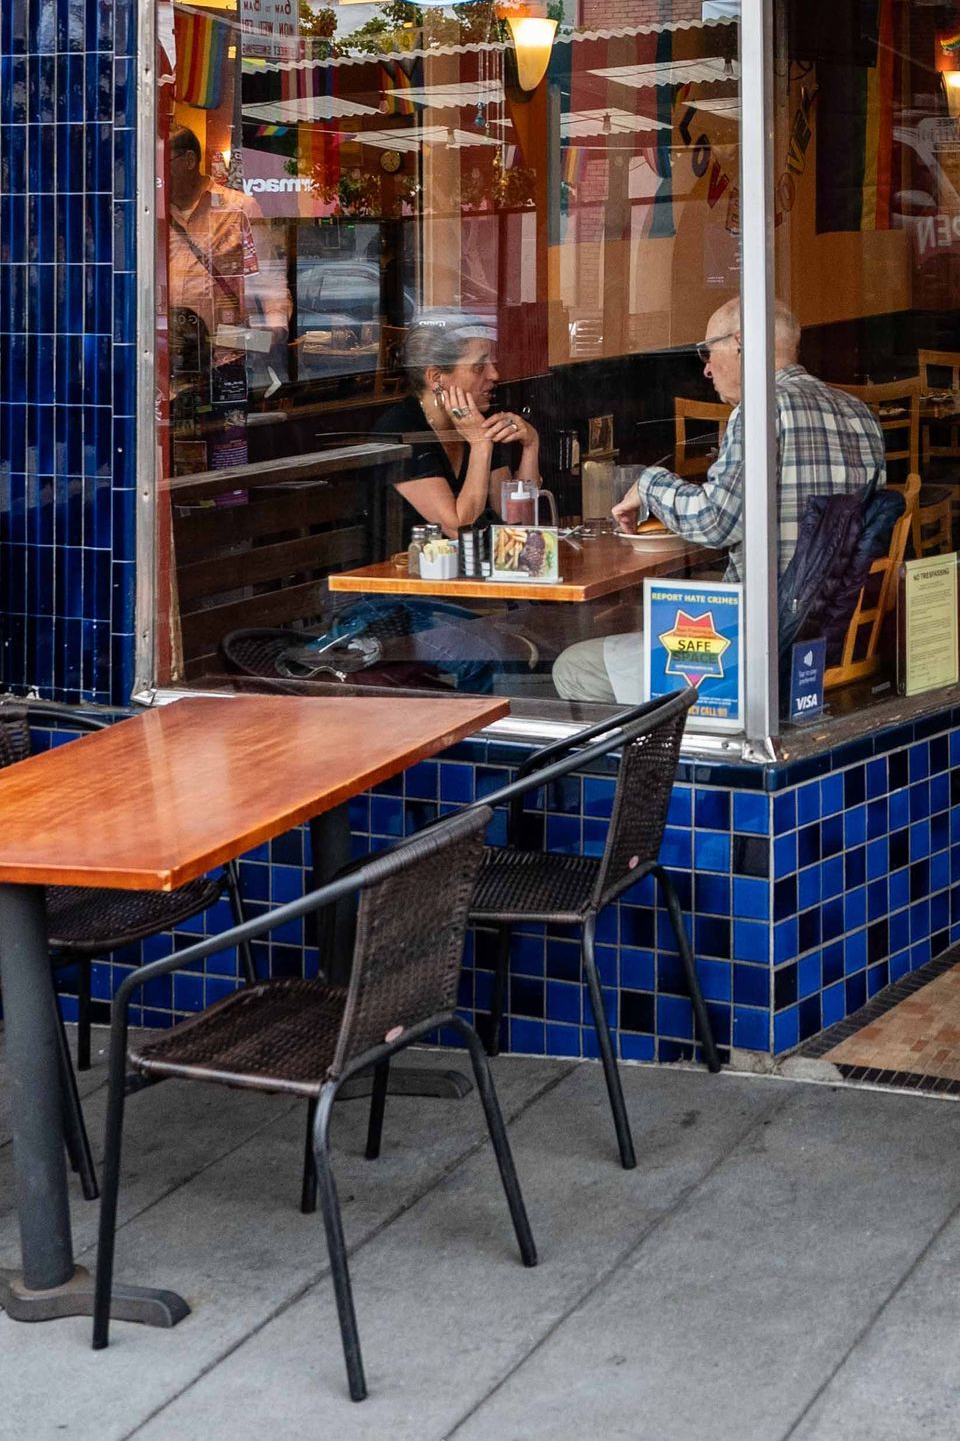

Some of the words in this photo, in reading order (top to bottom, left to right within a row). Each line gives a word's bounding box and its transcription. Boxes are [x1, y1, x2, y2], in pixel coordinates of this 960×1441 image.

[651, 592, 682, 601] REPORT
[684, 594, 706, 603] HATE
[707, 596, 738, 605] CRIMES
[678, 640, 711, 651] SAFE
[673, 652, 716, 663] SPACE
[796, 693, 818, 710] VISA
